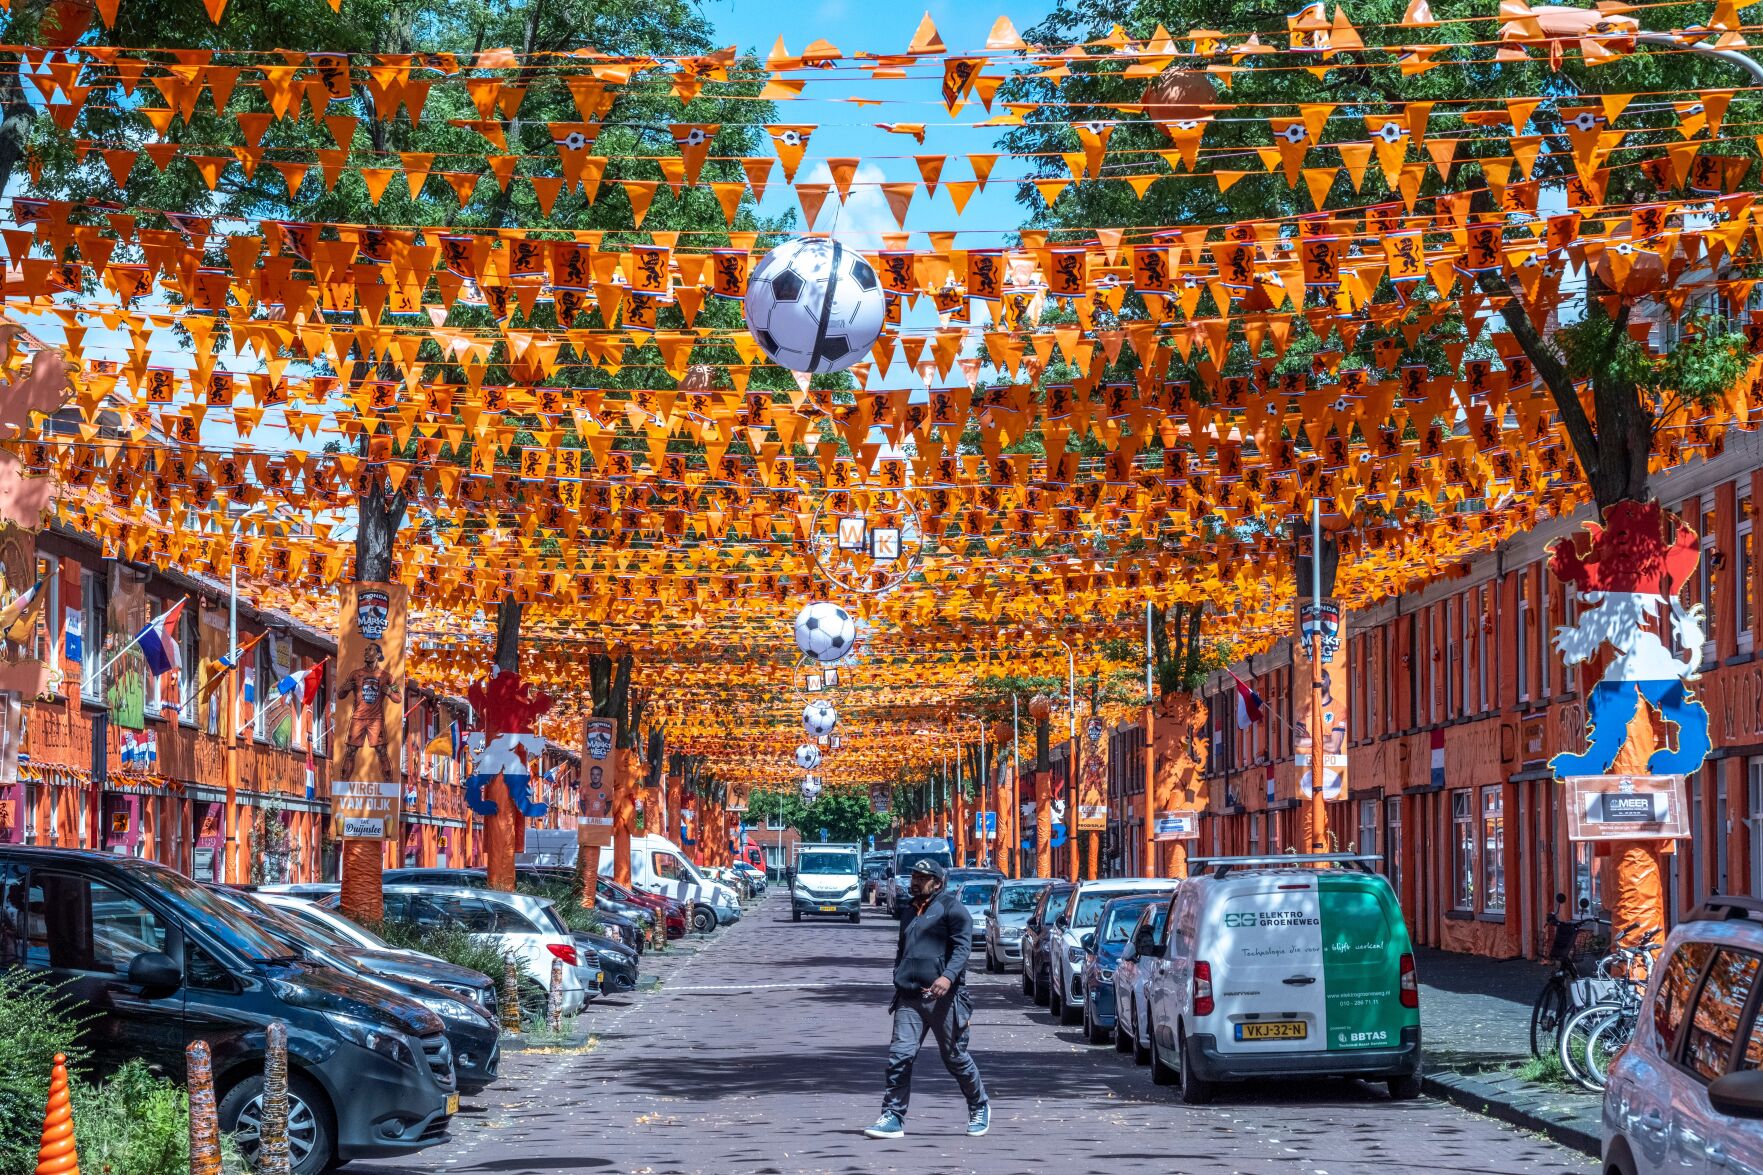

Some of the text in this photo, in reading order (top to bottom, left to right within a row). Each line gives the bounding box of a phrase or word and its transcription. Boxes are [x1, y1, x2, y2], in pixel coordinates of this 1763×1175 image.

[841, 524, 893, 556] W K
[358, 616, 389, 626] MARKT
[363, 625, 382, 635] WEG
[1306, 756, 1336, 765] GPO
[349, 783, 383, 795] VIRGIL
[340, 798, 391, 811] VAN DIJK
[1619, 799, 1648, 807] MEER
[1260, 918, 1320, 927] GROENEWEG
[1241, 947, 1286, 957] Technologie
[1246, 1024, 1302, 1037] VKJ-32-N
[1350, 1031, 1387, 1042] BBTAS
